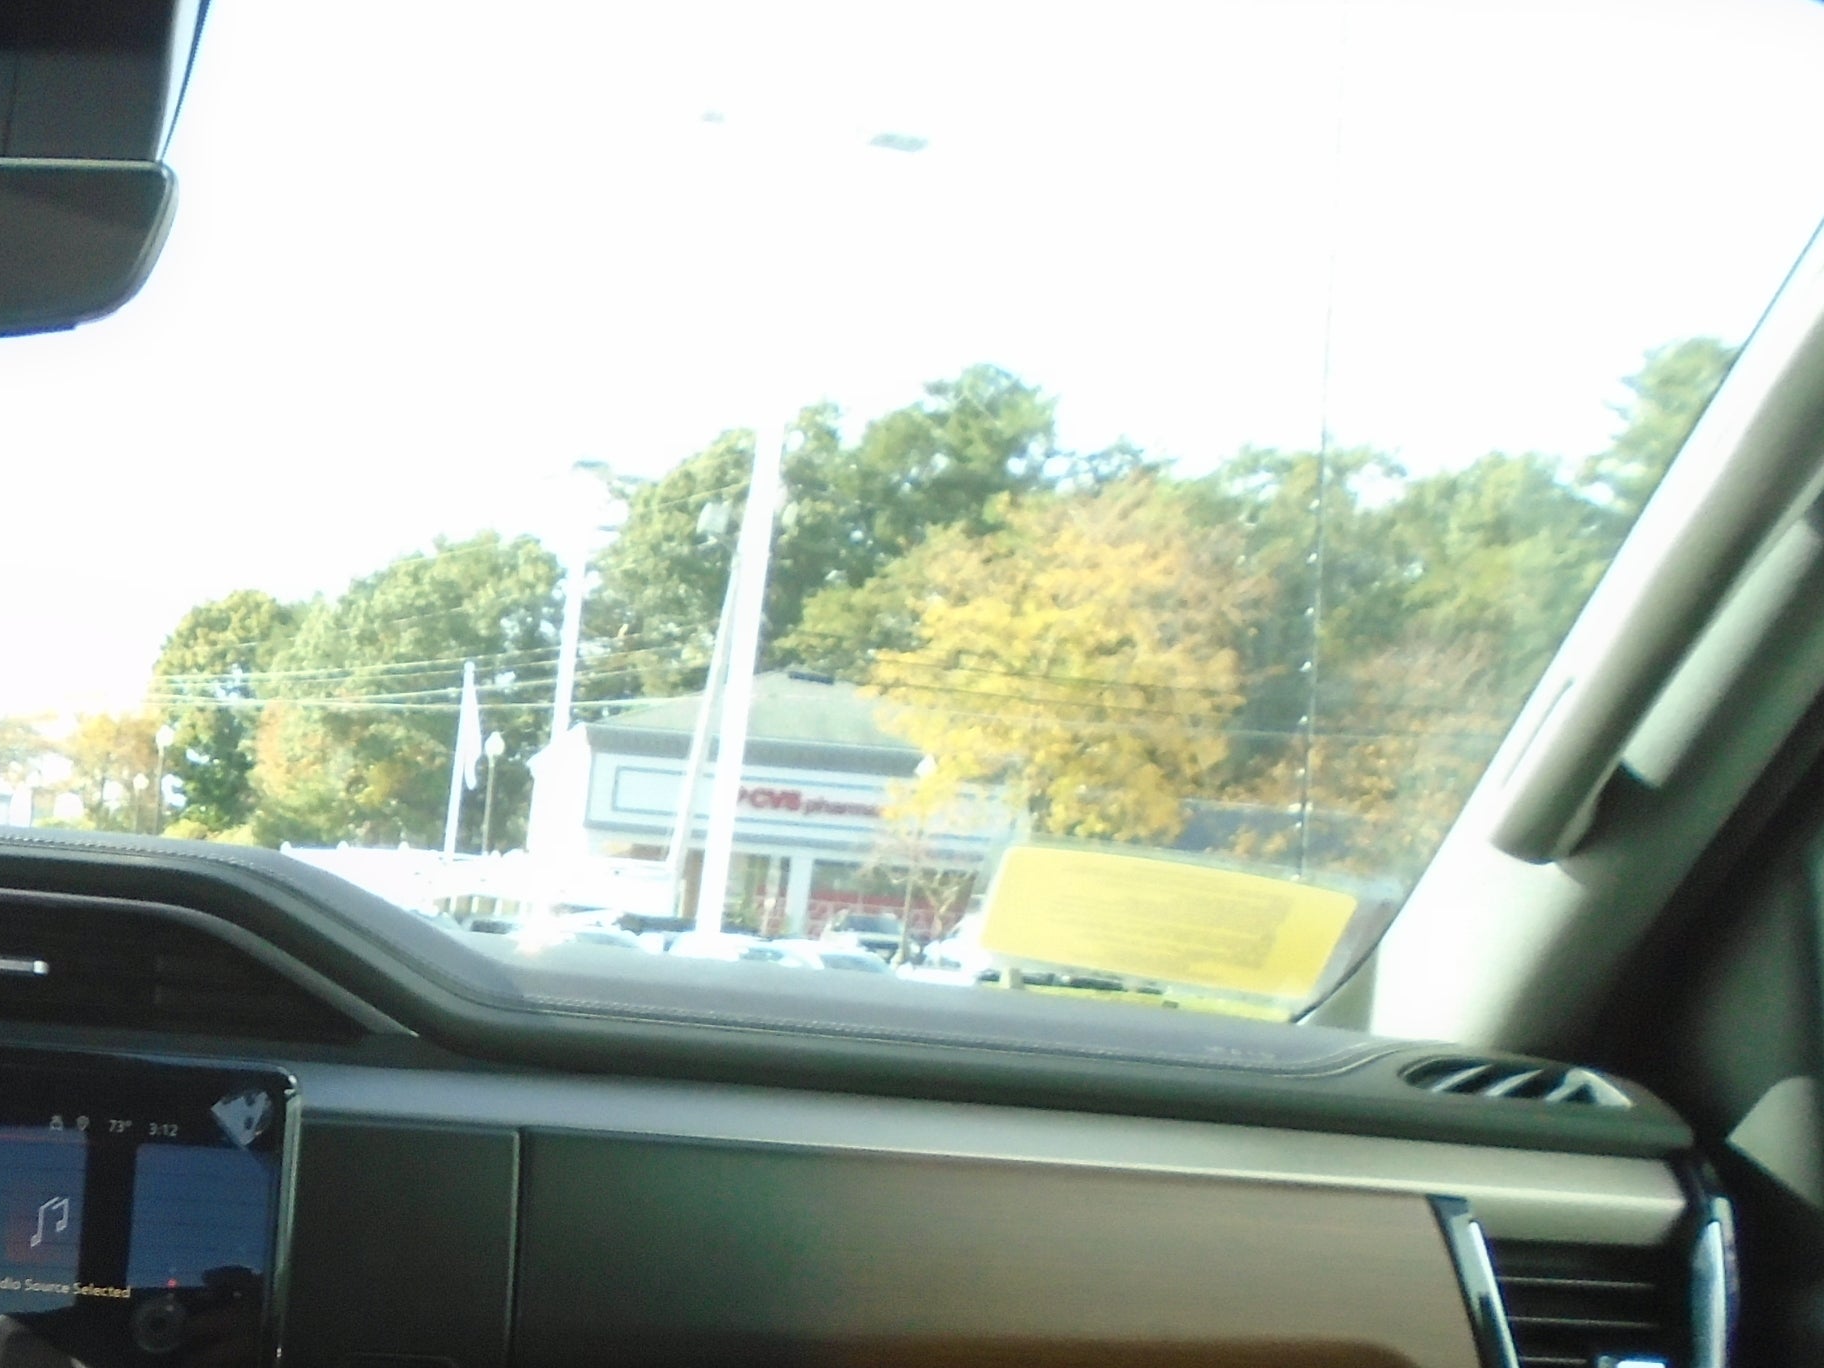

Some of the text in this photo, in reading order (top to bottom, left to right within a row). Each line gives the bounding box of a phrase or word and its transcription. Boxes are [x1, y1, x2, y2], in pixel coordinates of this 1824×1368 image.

[148, 1122, 179, 1137] 3:12
[24, 1278, 71, 1294] Source
[73, 1282, 132, 1298] Selected
